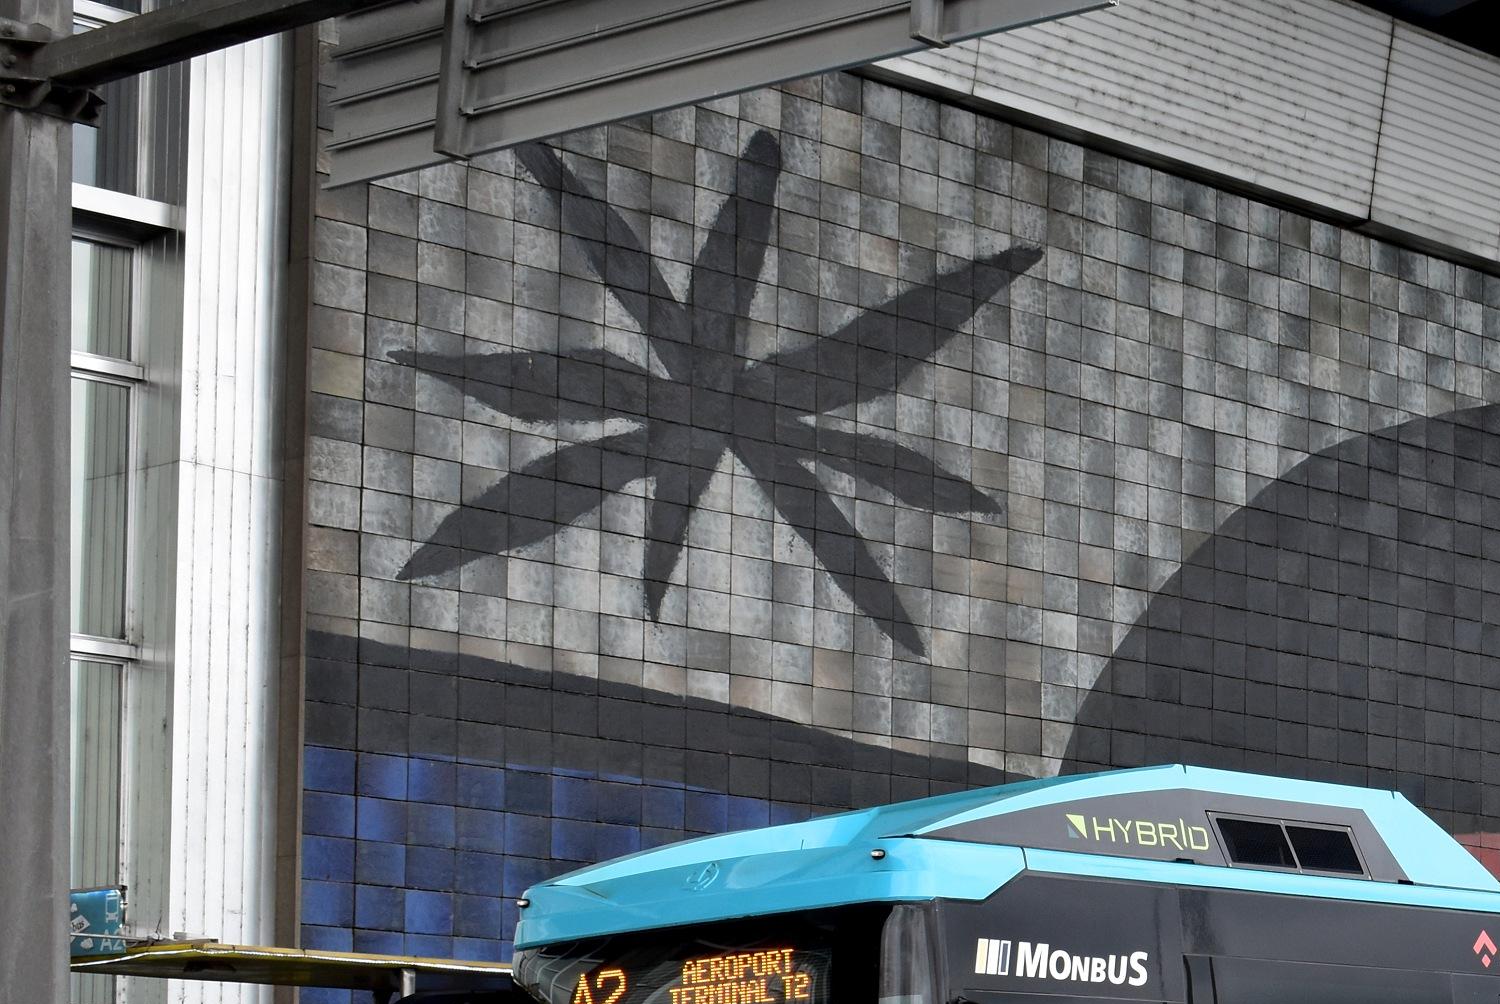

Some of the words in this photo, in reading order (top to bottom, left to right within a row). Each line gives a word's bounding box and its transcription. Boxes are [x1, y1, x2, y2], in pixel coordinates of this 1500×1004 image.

[1092, 816, 1210, 851] HYBRID
[682, 948, 795, 985] AEROPORT
[781, 971, 810, 1001] T2
